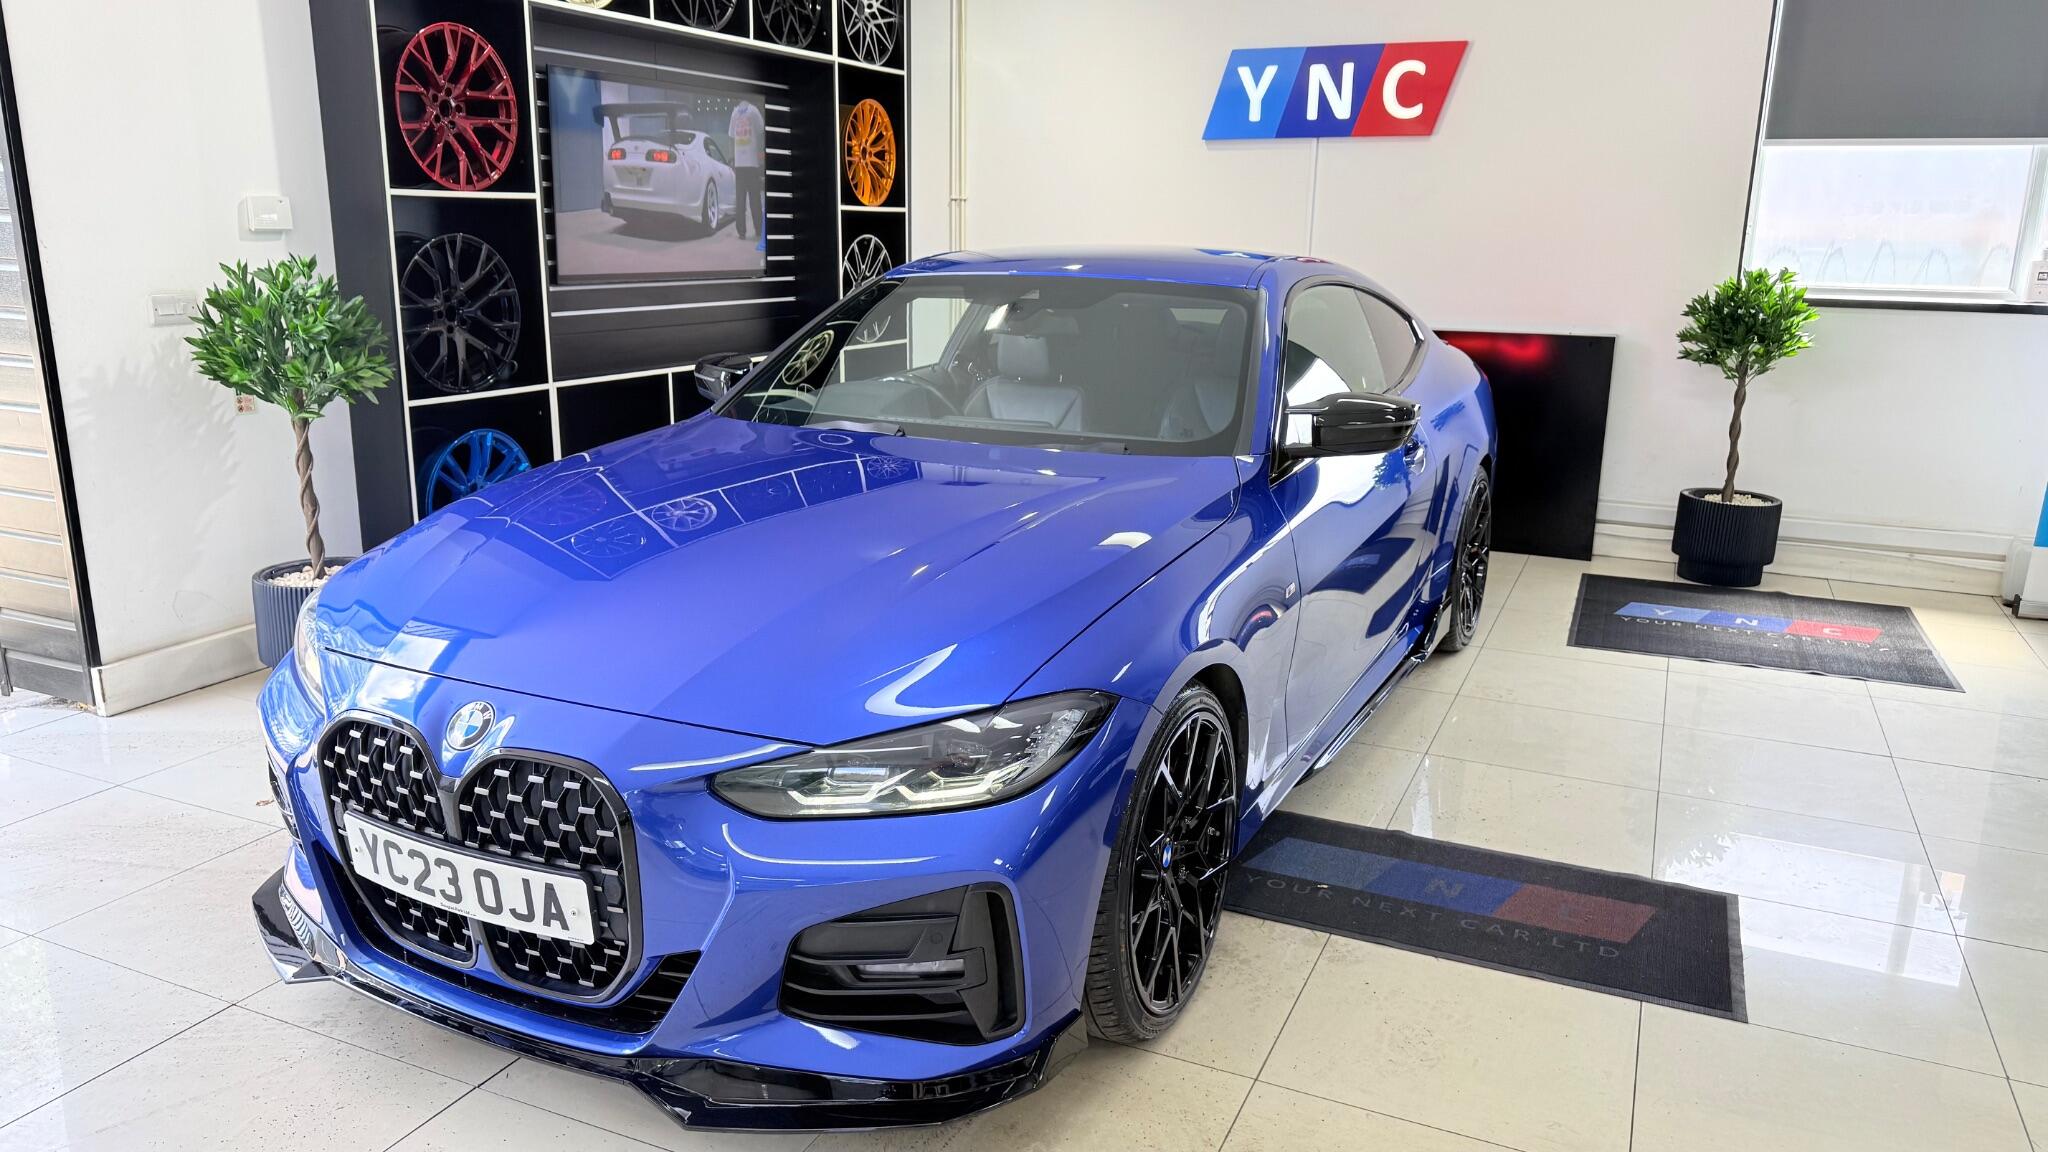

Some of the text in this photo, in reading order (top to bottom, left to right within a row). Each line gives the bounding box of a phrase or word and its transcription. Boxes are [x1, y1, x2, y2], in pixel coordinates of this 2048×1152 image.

[1237, 59, 1427, 122] YNC
[1621, 615, 1682, 628] YOUR
[1695, 623, 1754, 636] NEXT
[359, 827, 570, 931] YC23 OJA
[1247, 874, 1333, 900] YOUR
[1352, 896, 1442, 922] NEXT
[1552, 935, 1619, 958] LTD
